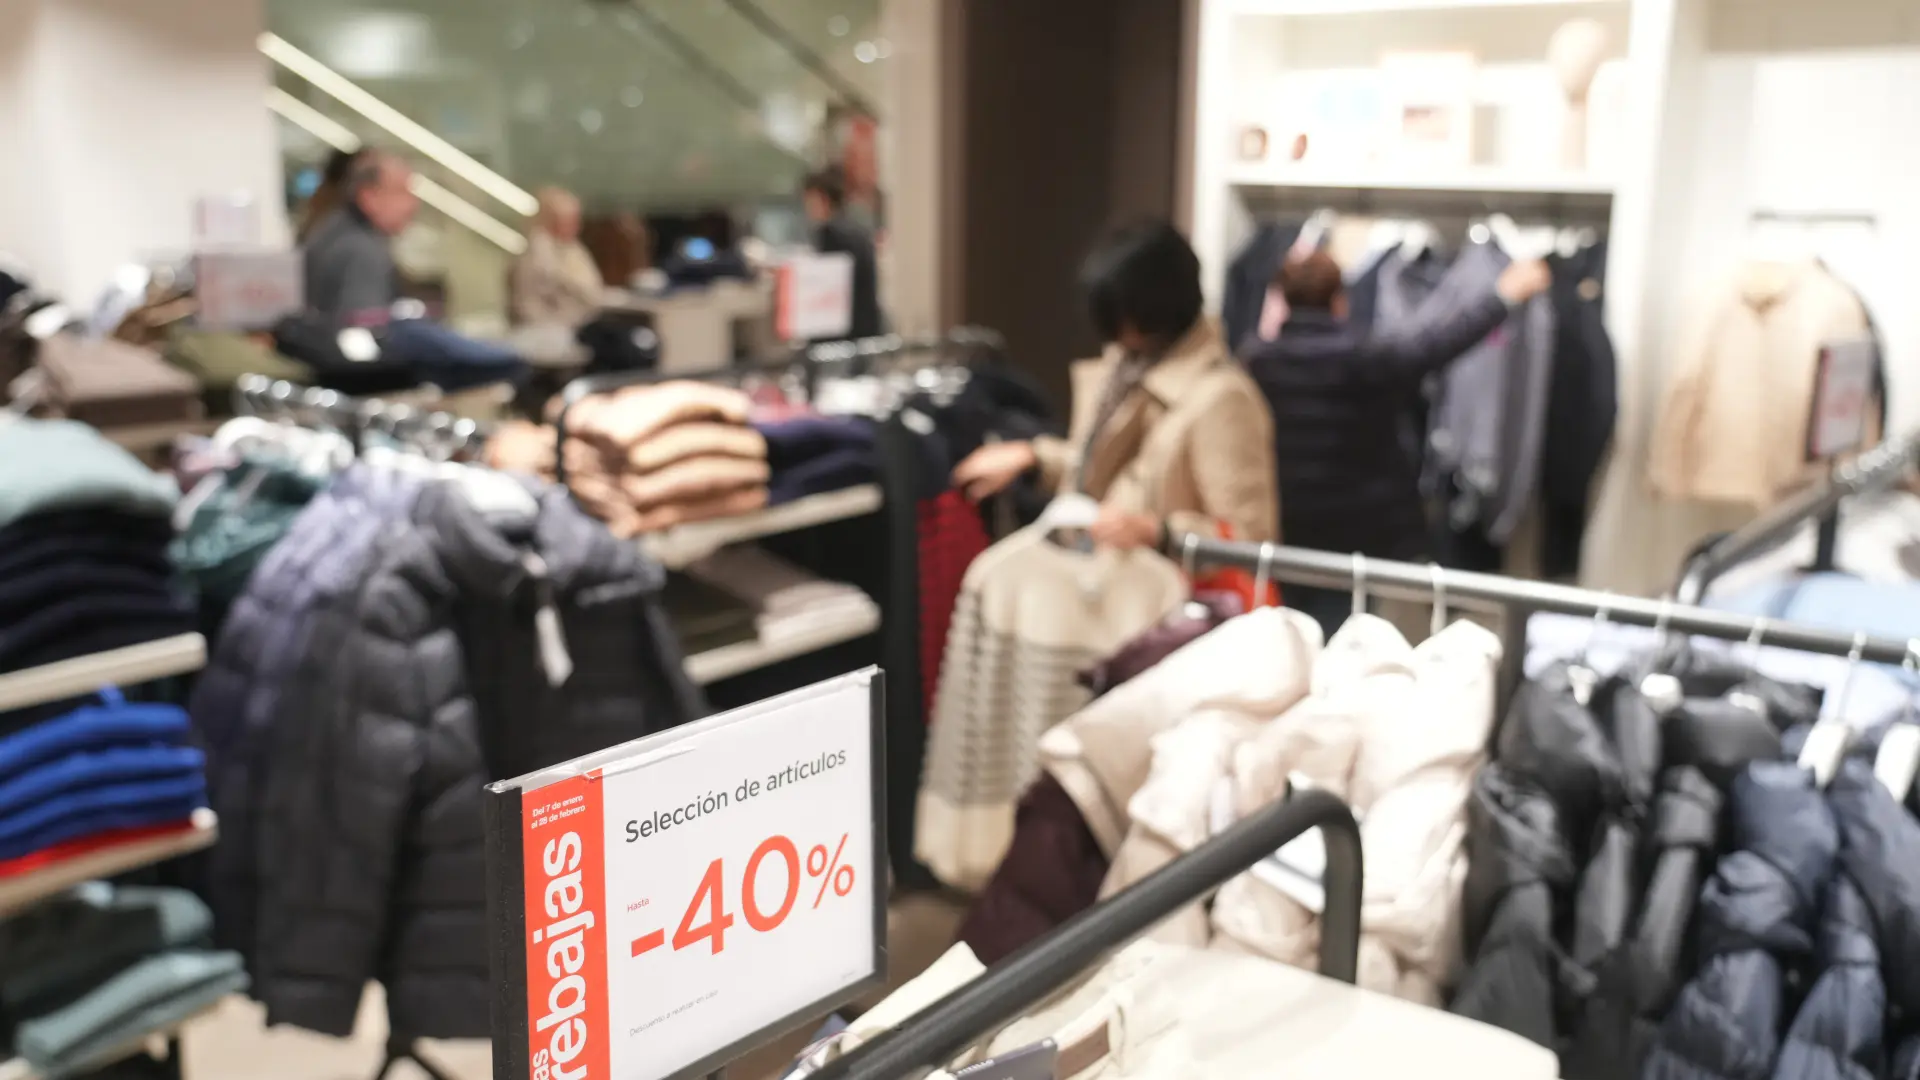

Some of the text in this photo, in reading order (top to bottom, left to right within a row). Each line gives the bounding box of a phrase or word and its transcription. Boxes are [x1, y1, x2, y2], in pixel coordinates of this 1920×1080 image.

[531, 820, 538, 829] al
[549, 812, 558, 823] de
[560, 805, 586, 819] febrero
[532, 795, 584, 817] Del 7 de enero
[625, 749, 847, 843] Selección de artículos
[627, 898, 650, 913] Hasta
[631, 832, 855, 957] -40%
[533, 831, 595, 1080] rebajas
